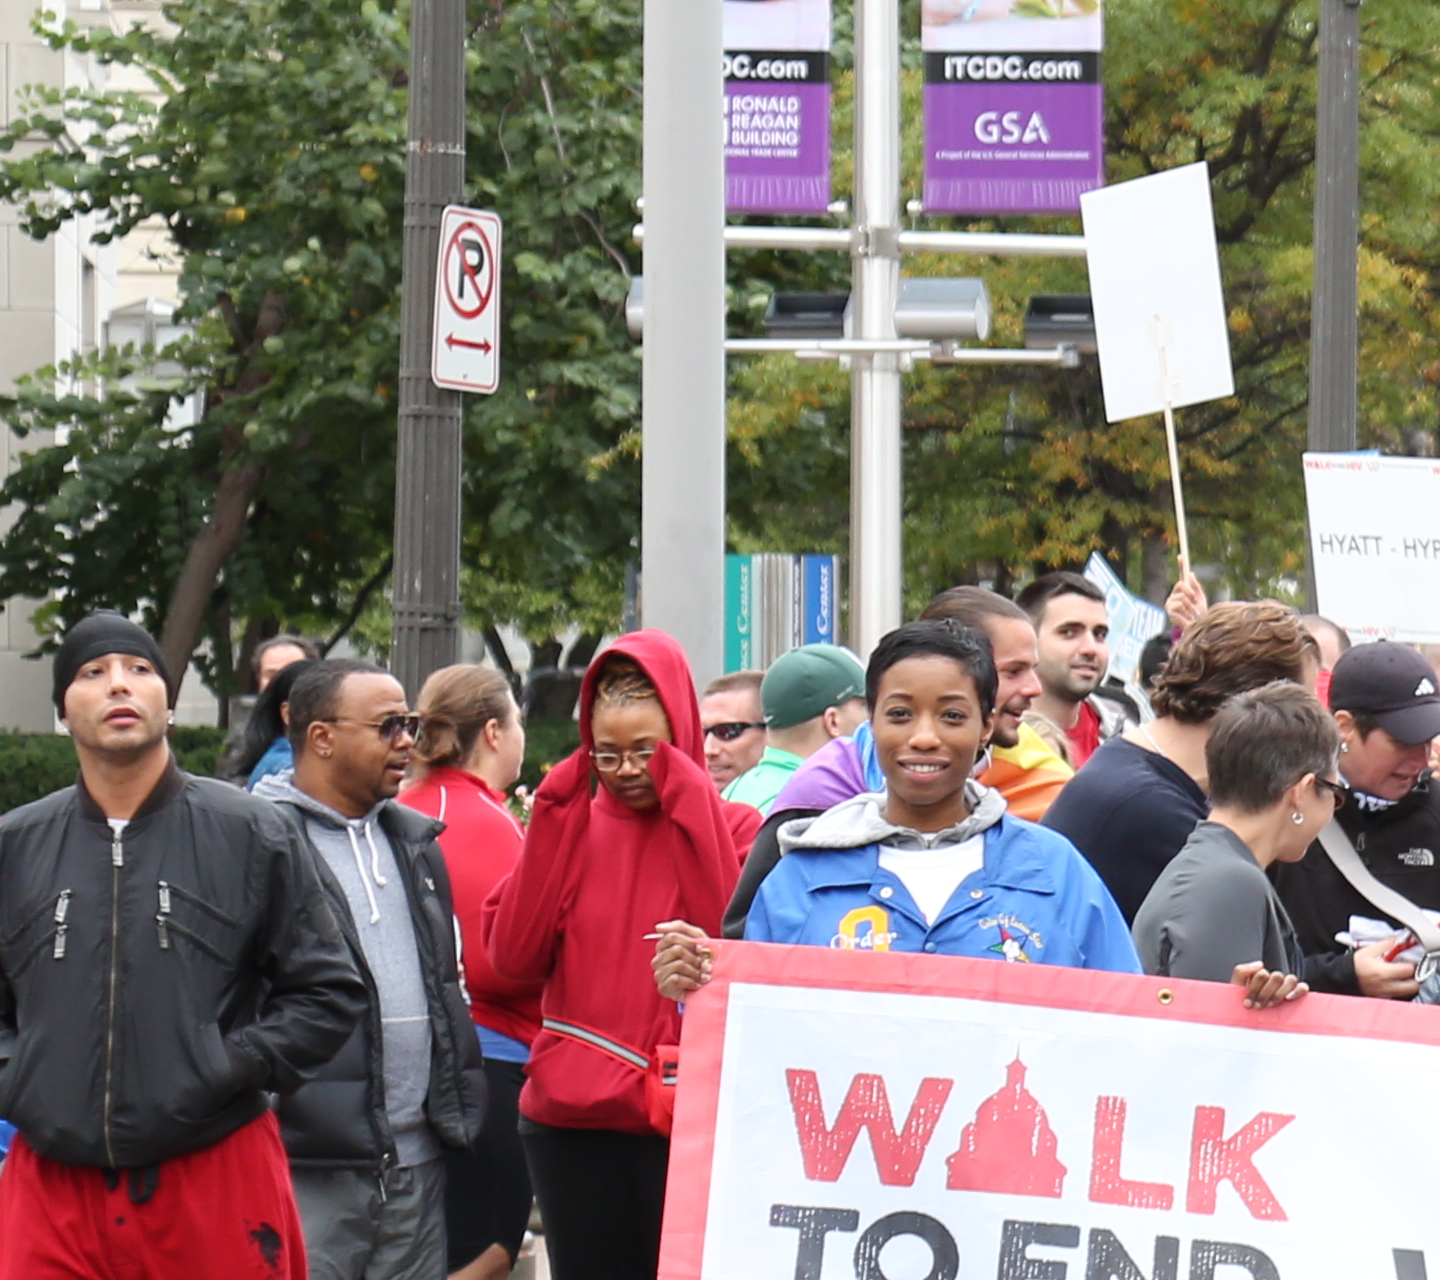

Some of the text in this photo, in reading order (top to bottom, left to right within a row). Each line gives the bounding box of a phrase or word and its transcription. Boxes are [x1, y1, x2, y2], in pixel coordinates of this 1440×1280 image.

[944, 55, 1082, 80] ITCDC.com
[732, 95, 799, 113] RONALD
[732, 114, 799, 130] REAGAN
[974, 111, 1051, 144] GSA
[732, 130, 799, 146] BUILDING
[1319, 532, 1382, 557] HYATT
[830, 929, 898, 950] Order
[785, 1045, 1296, 1222] WALK
